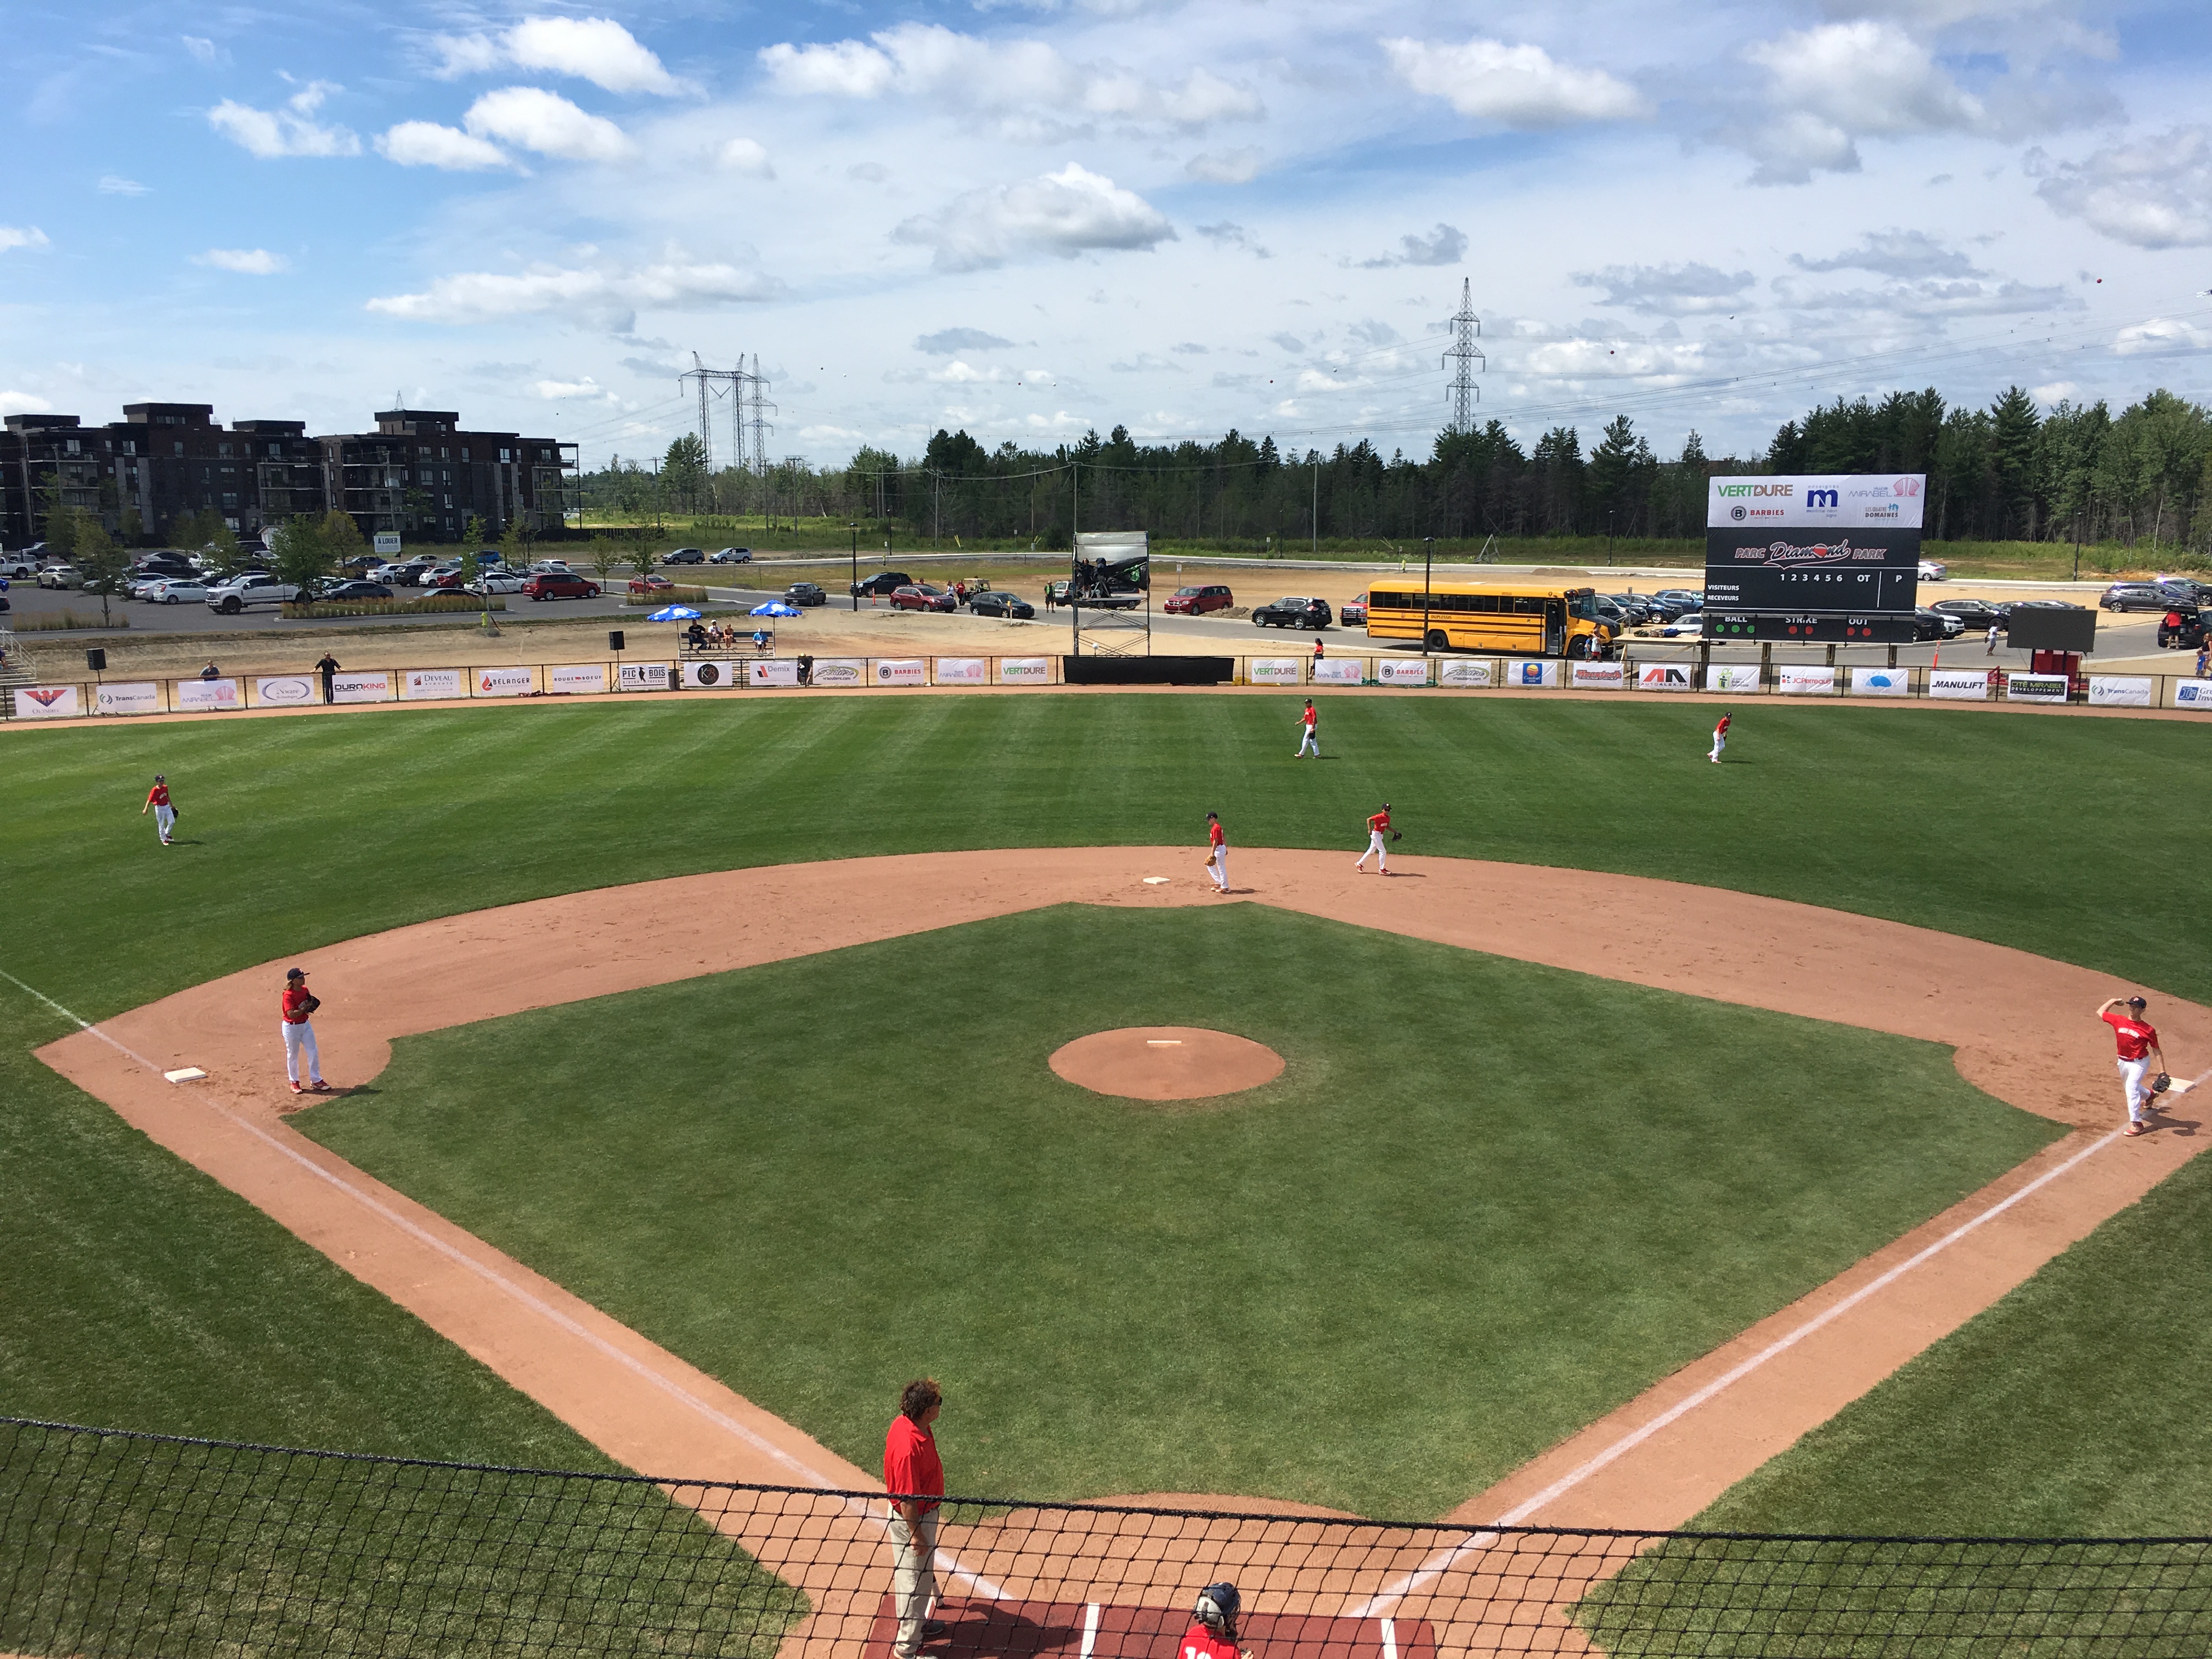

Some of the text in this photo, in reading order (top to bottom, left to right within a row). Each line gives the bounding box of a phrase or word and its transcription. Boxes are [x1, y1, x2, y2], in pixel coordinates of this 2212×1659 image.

[1717, 484, 1793, 497] VERTDURE
[1735, 539, 1887, 560] PARC Diamond PARK
[1003, 667, 1046, 675] VERTDURE
[1932, 681, 1985, 689] MANULIFT
[1186, 1646, 1211, 1659] 1
